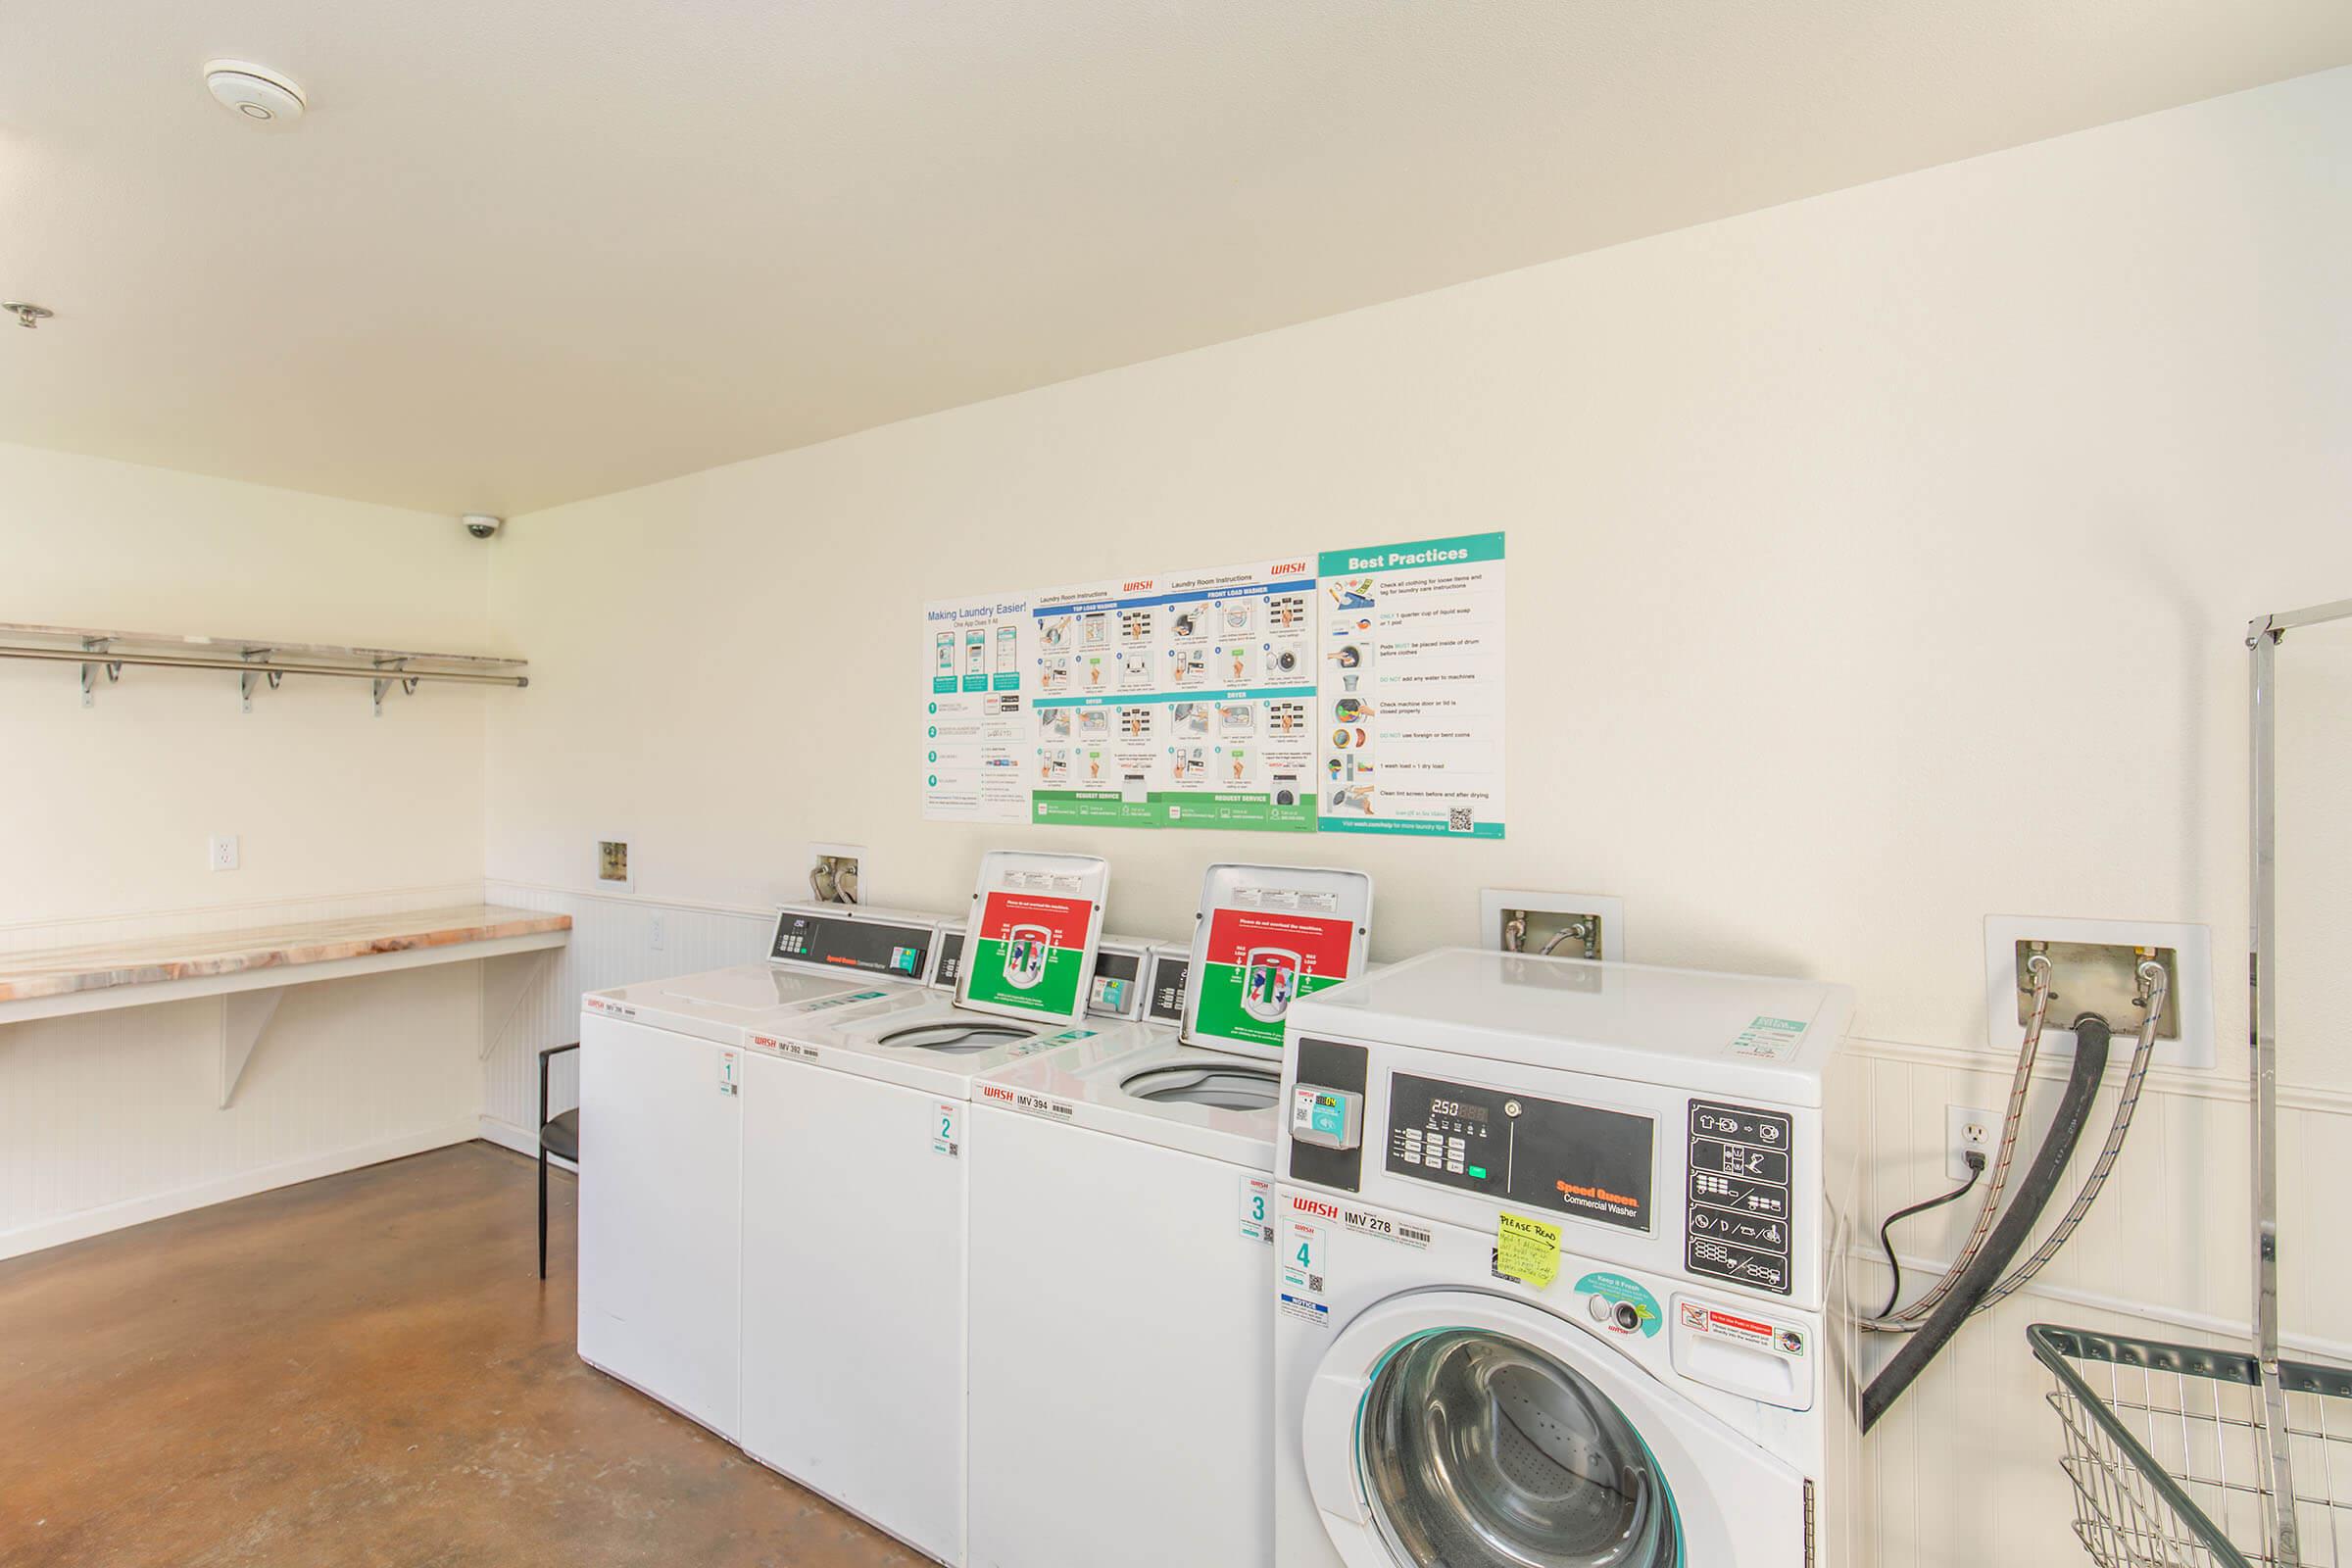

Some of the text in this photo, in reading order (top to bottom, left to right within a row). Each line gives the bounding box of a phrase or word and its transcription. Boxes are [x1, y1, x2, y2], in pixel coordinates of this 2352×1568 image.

[1348, 548, 1468, 569] Best Practices
[1271, 563, 1305, 574] WASH
[1123, 580, 1152, 592] WASH
[1216, 574, 1252, 583] Instructions
[928, 602, 1026, 620] Making Laundry Easier!
[755, 1037, 776, 1048] WASH
[725, 1064, 731, 1081] 1
[984, 1086, 1048, 1109] WASH IMV 394
[1432, 1100, 1458, 1116] 2.50
[942, 1118, 950, 1138] 2
[1556, 1180, 1595, 1198] Speed
[1253, 1197, 1264, 1220] 3
[1564, 1194, 1637, 1217] Commercial Washer
[1294, 1198, 1391, 1233] WASH IMV 278
[1295, 1224, 1314, 1234] WASH
[1499, 1215, 1556, 1241] PLEASE READ
[1297, 1243, 1310, 1268] 4
[1597, 1275, 1614, 1284] Keep
[1621, 1282, 1640, 1292] Fresh
[1293, 1298, 1316, 1310] NOTICE
